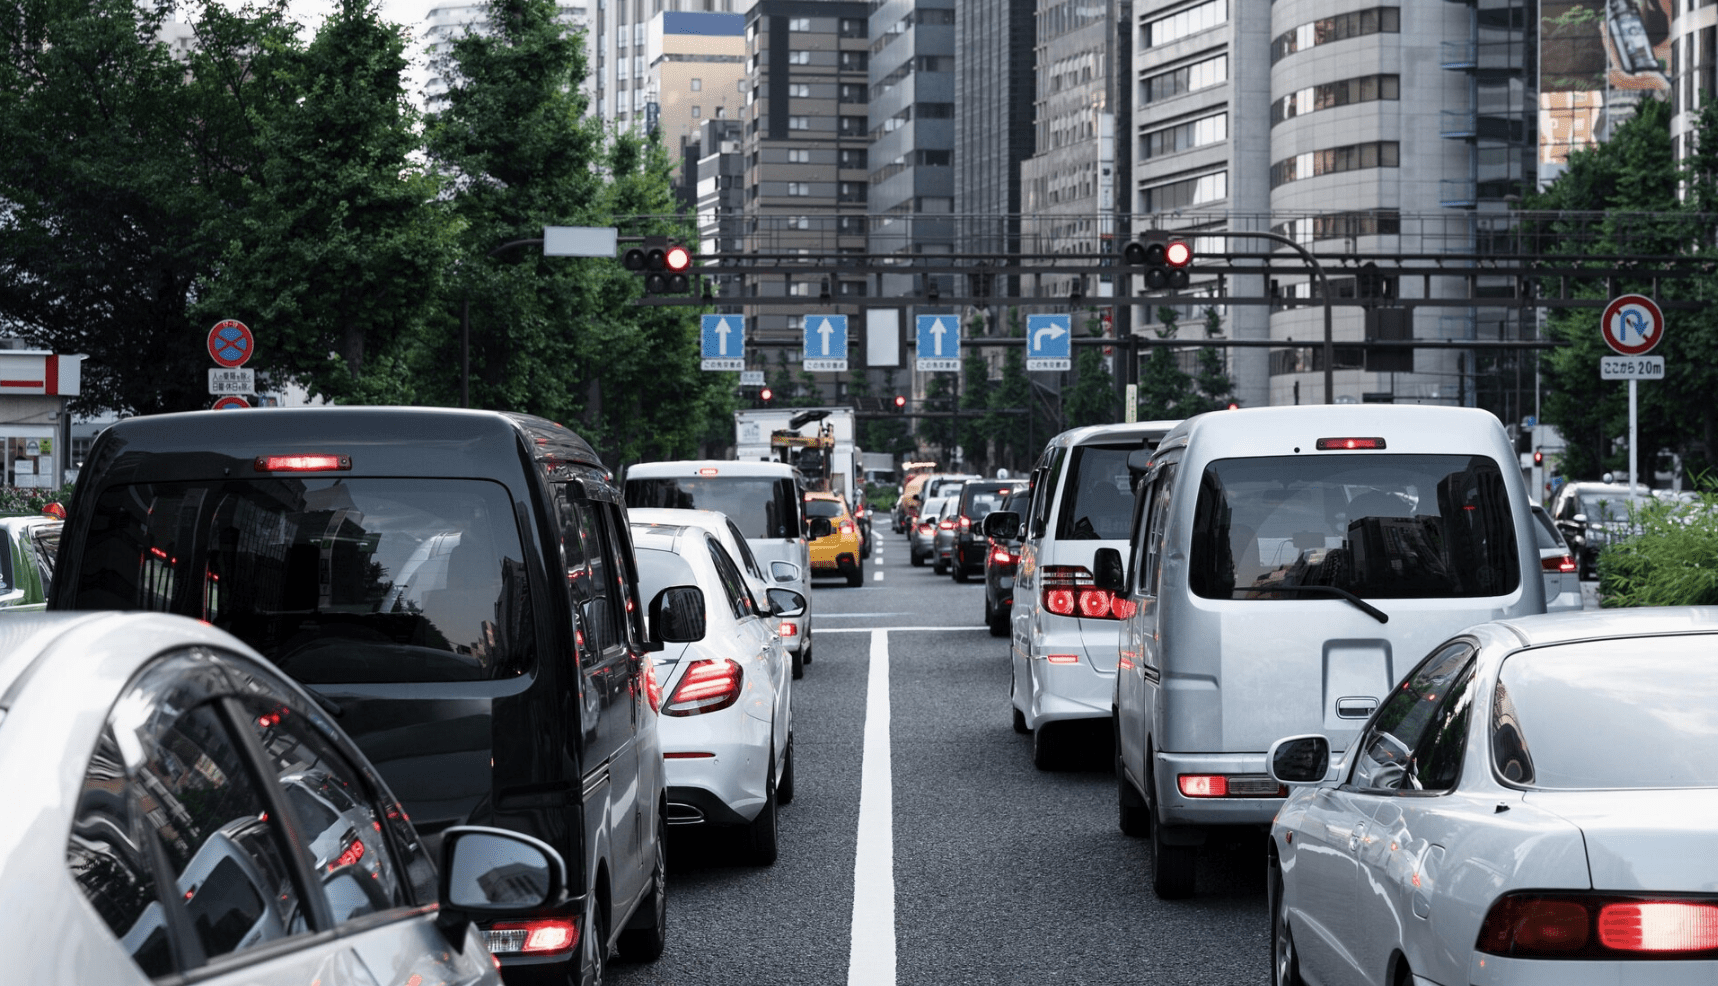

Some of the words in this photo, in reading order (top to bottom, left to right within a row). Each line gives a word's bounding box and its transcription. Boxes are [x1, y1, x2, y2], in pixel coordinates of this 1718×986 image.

[1604, 361, 1635, 374] ここから
[1638, 361, 1662, 374] 20m
